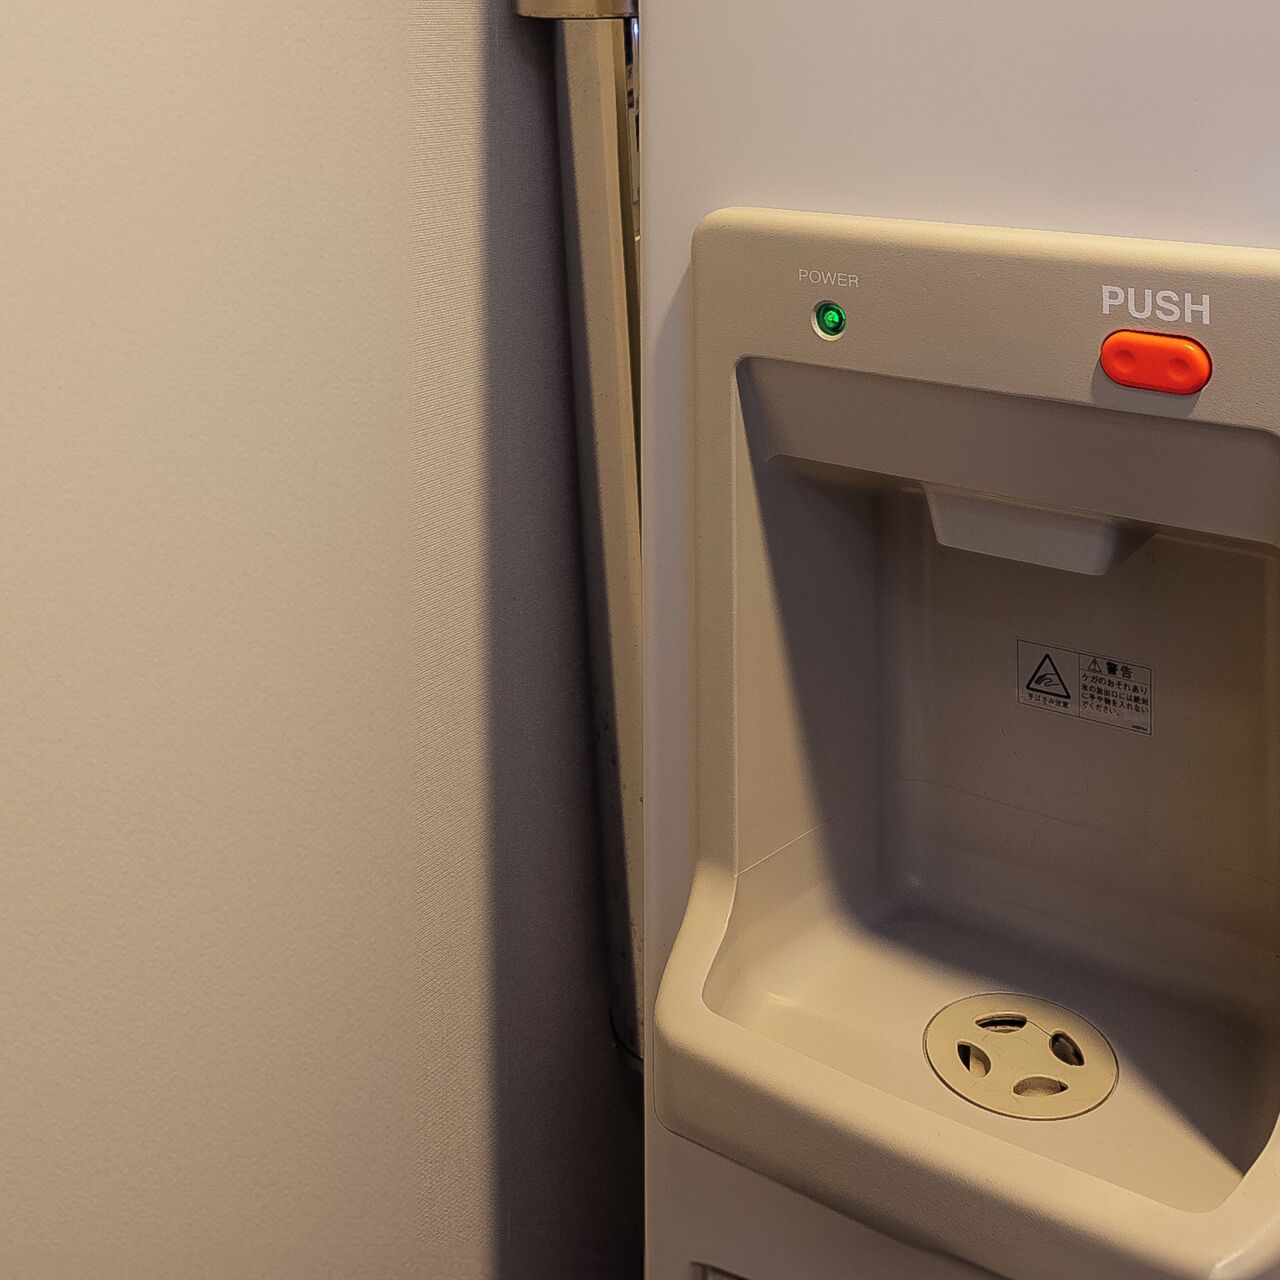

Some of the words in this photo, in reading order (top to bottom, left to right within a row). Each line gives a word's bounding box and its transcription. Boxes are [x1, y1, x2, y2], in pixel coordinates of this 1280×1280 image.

[798, 269, 860, 288] POWER
[1102, 284, 1212, 325] PUSH
[1105, 661, 1133, 680] 警告
[1081, 673, 1148, 695] ケガのおそれあり
